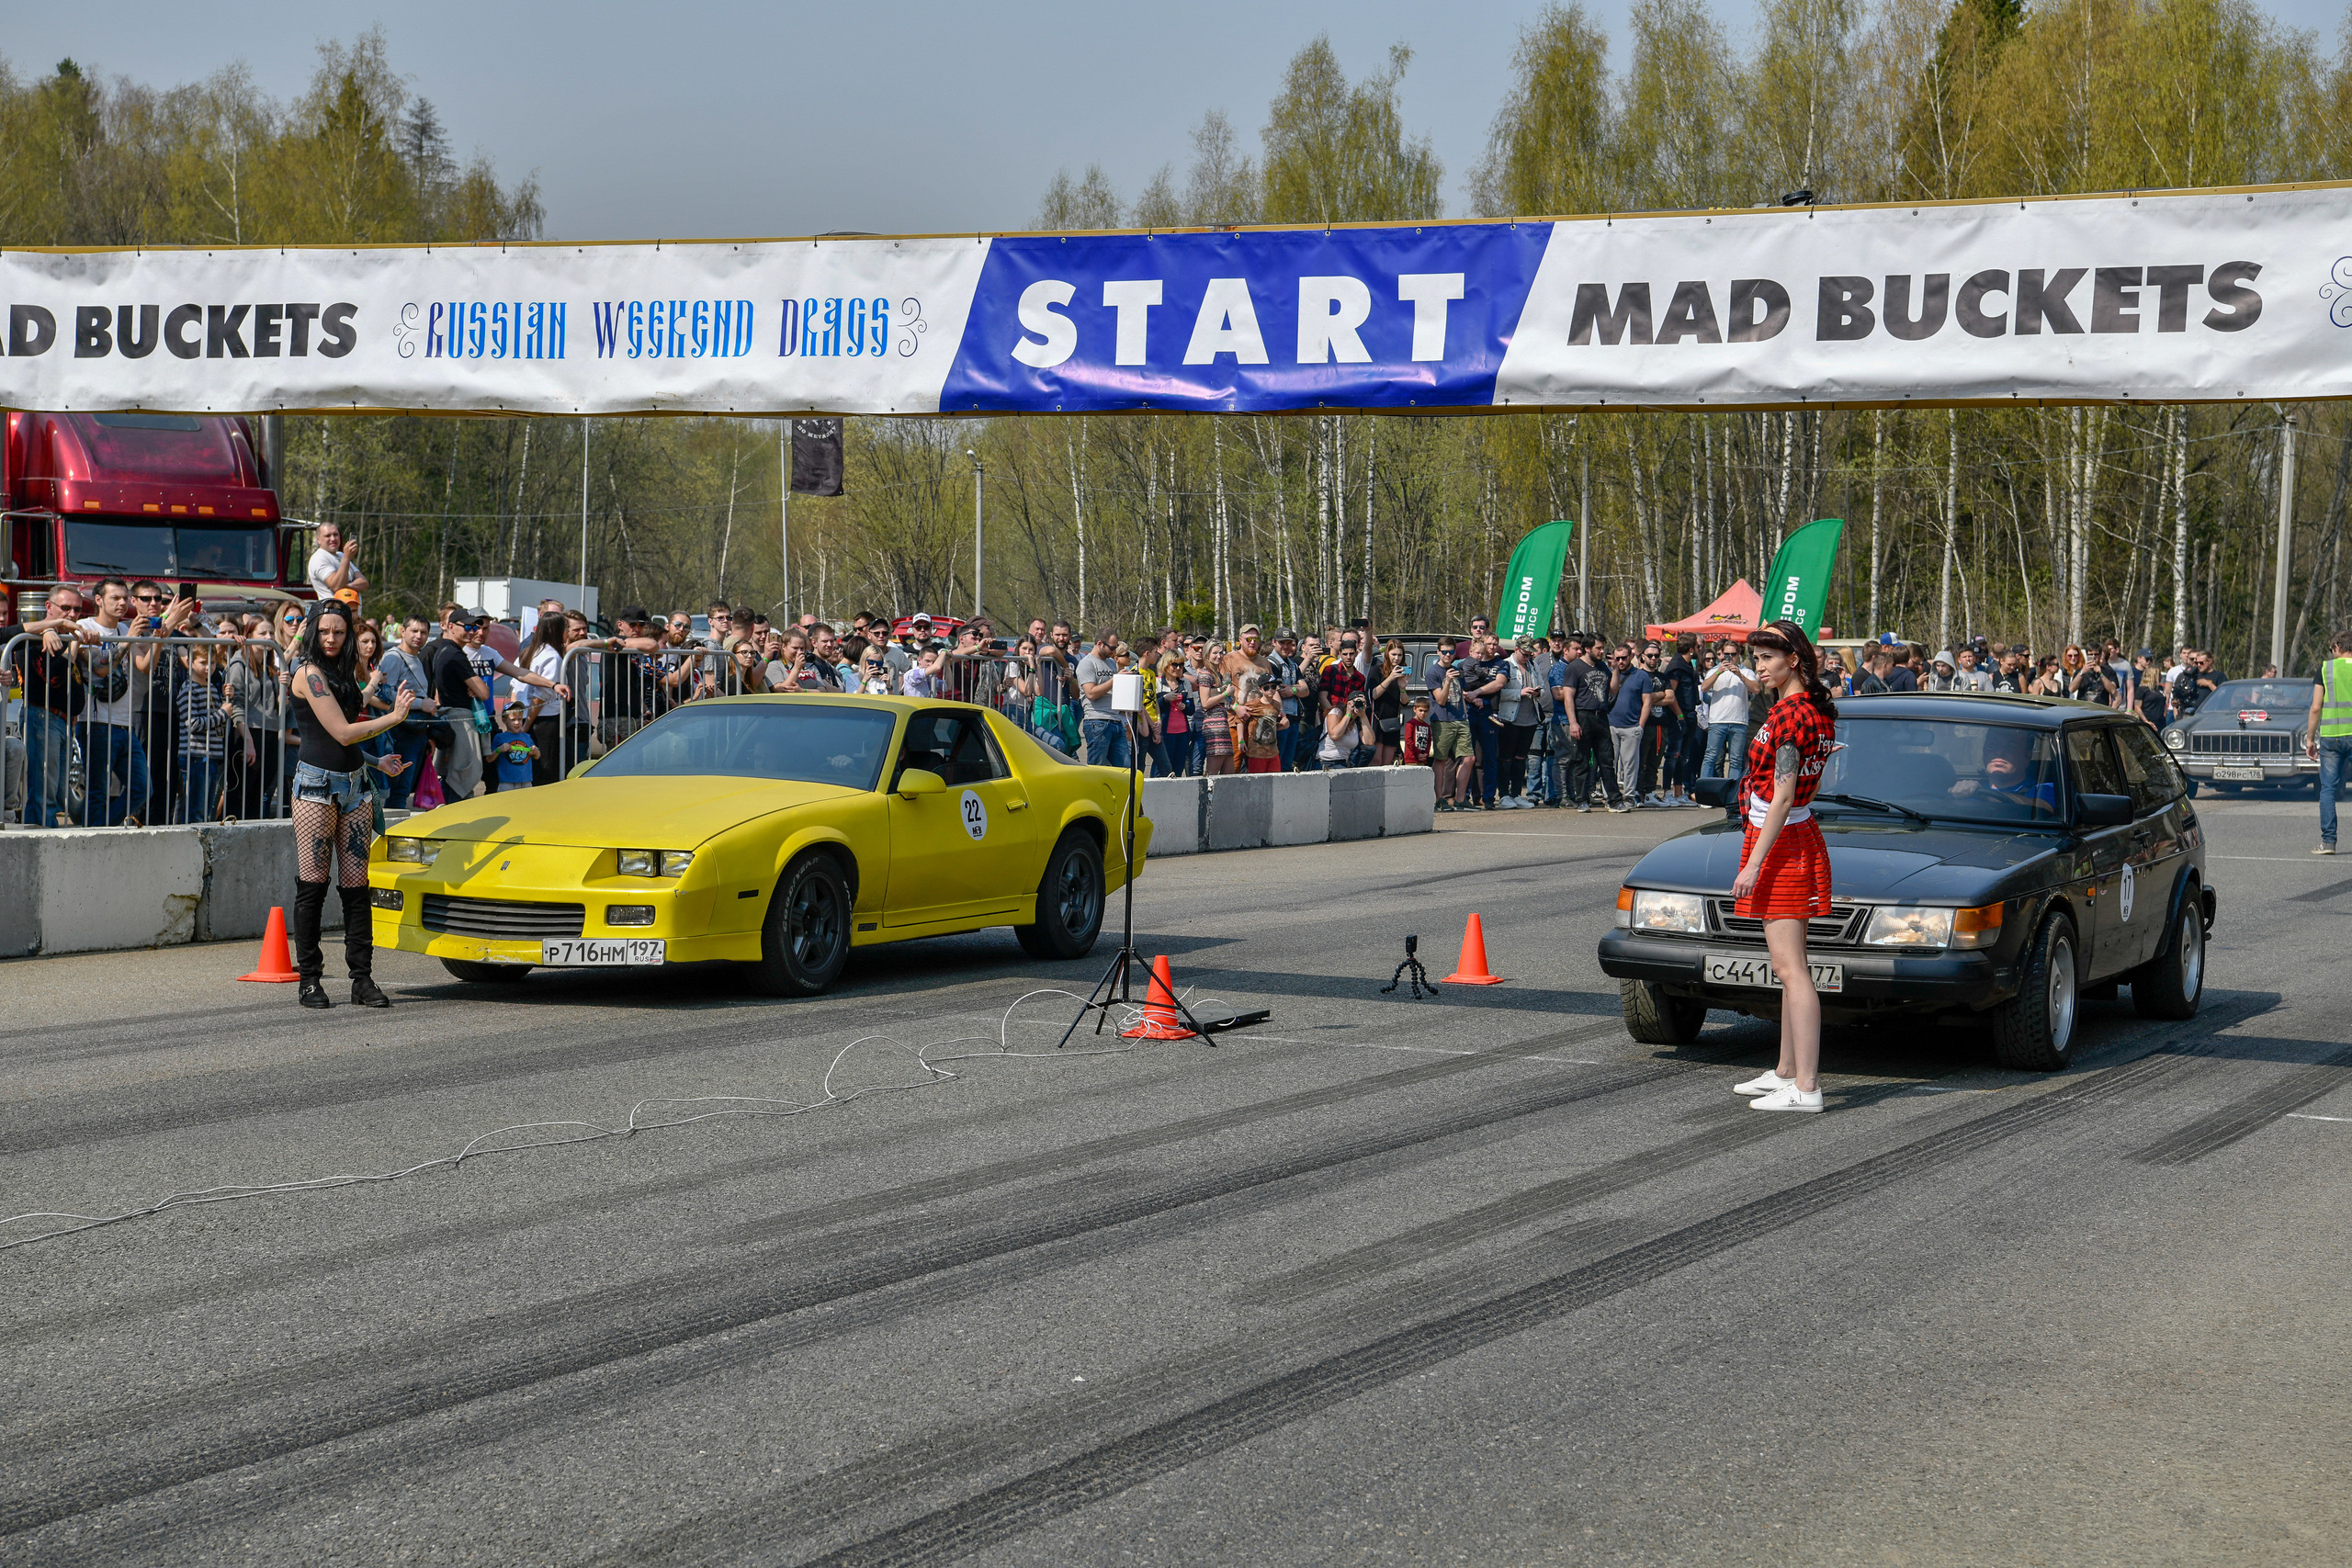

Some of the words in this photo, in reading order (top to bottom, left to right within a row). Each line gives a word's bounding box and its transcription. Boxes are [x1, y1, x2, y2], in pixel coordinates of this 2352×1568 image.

[74, 302, 358, 359] BUCKETS
[424, 301, 567, 359] RUSSIAN
[594, 299, 753, 359] WEEKEND
[778, 297, 889, 358] DRAGS
[1011, 272, 1465, 368] START
[1566, 278, 1792, 346] MAD
[1816, 261, 2263, 342] BUCKETS
[1511, 576, 1533, 641] REEDOM
[1525, 607, 1539, 638] ance
[964, 798, 982, 823] 22
[629, 941, 660, 956] 197
[1813, 981, 1827, 989] US
